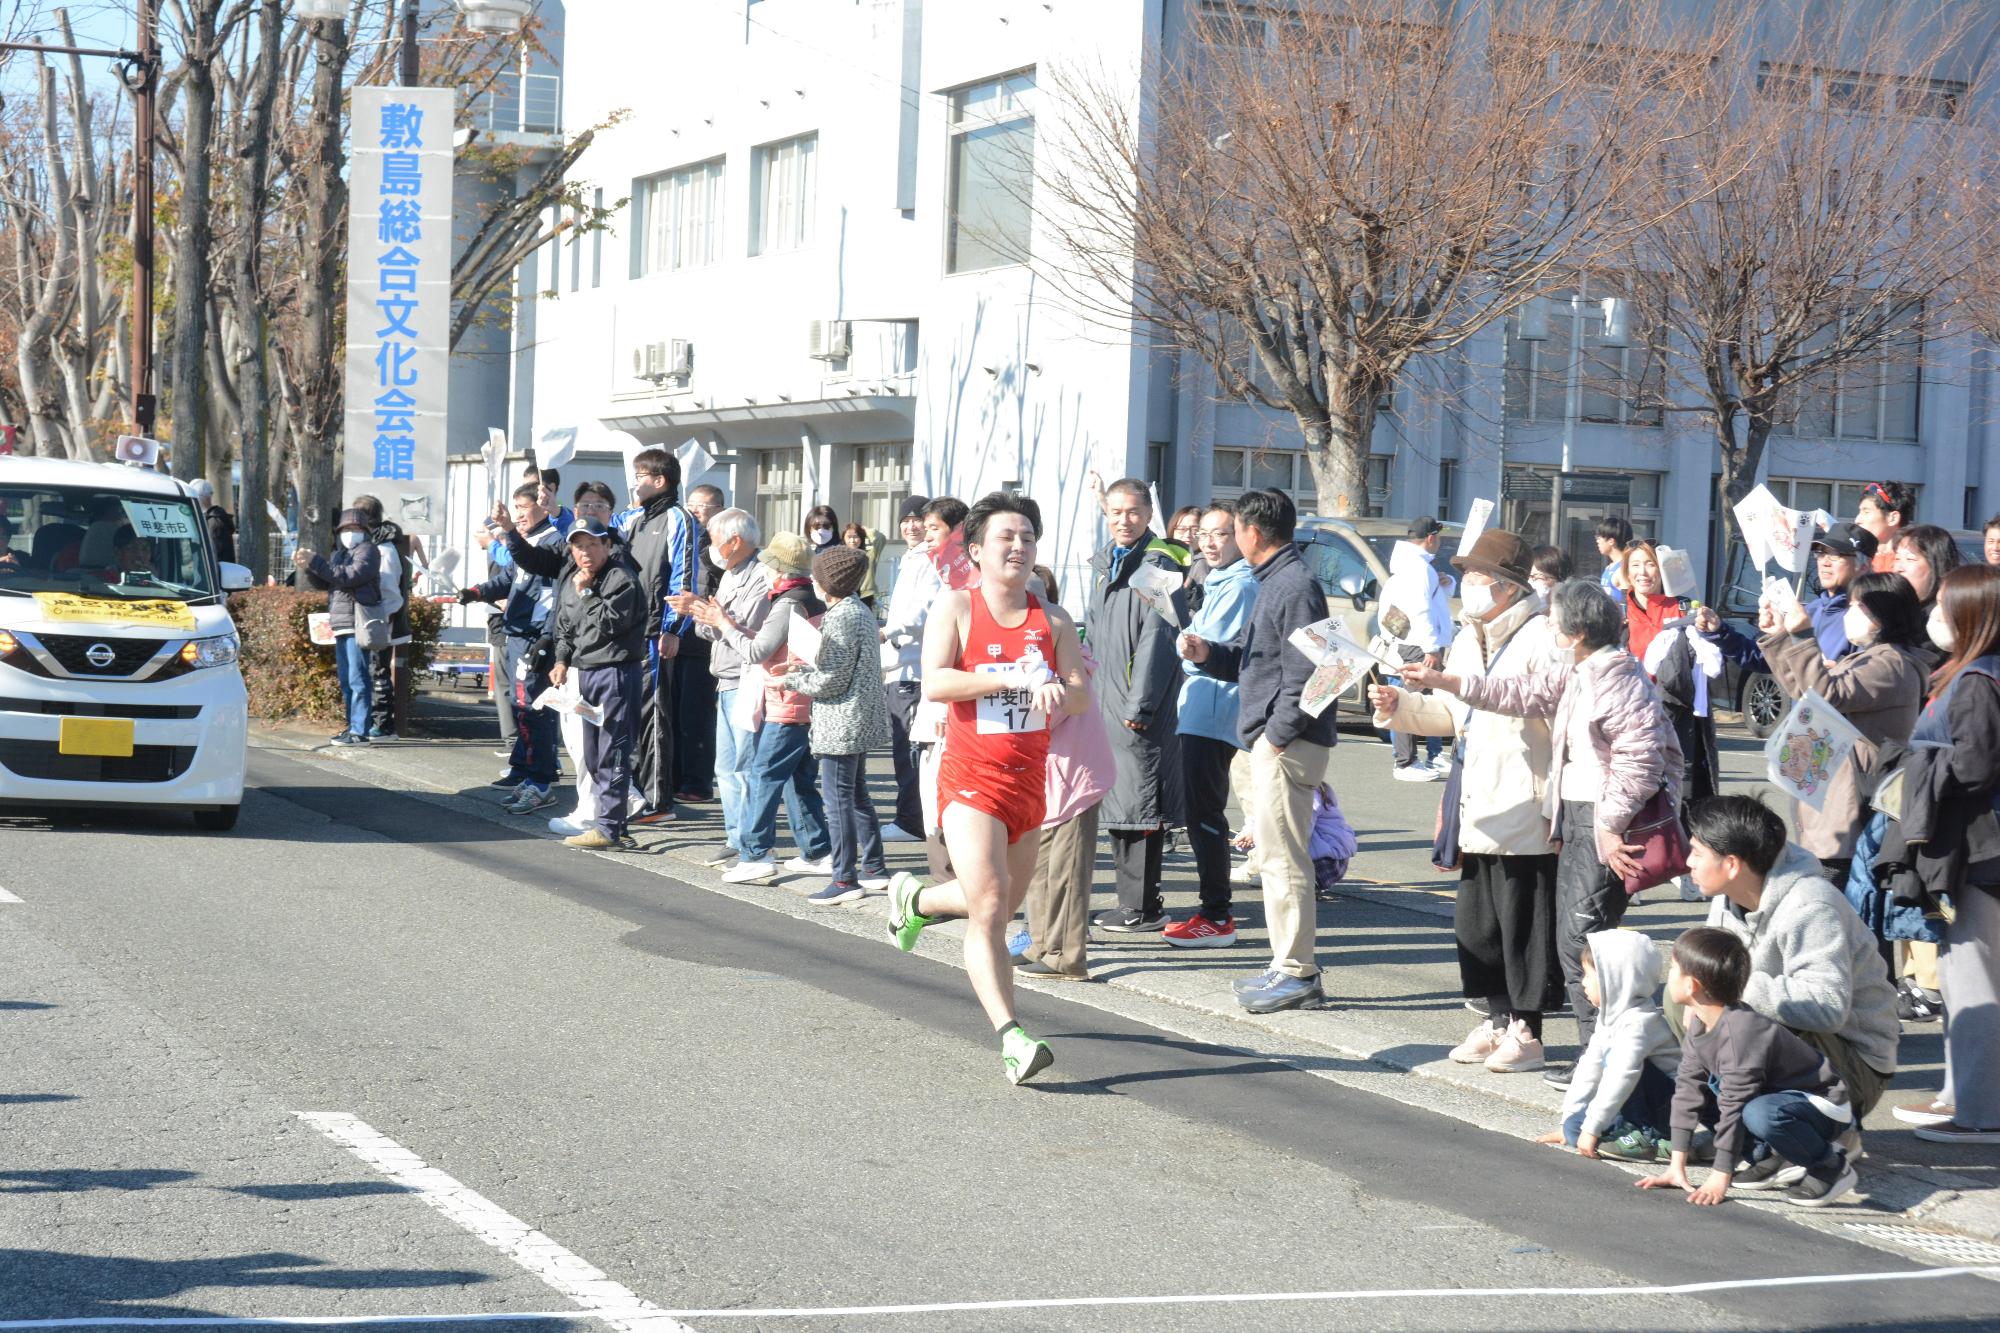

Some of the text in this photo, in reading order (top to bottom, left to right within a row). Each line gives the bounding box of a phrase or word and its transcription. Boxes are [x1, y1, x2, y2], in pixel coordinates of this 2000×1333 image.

[373, 102, 423, 482] 敷島総合文化会館
[146, 507, 168, 520] 17
[141, 520, 188, 534] 甲斐市B
[1003, 708, 1031, 730] 17
